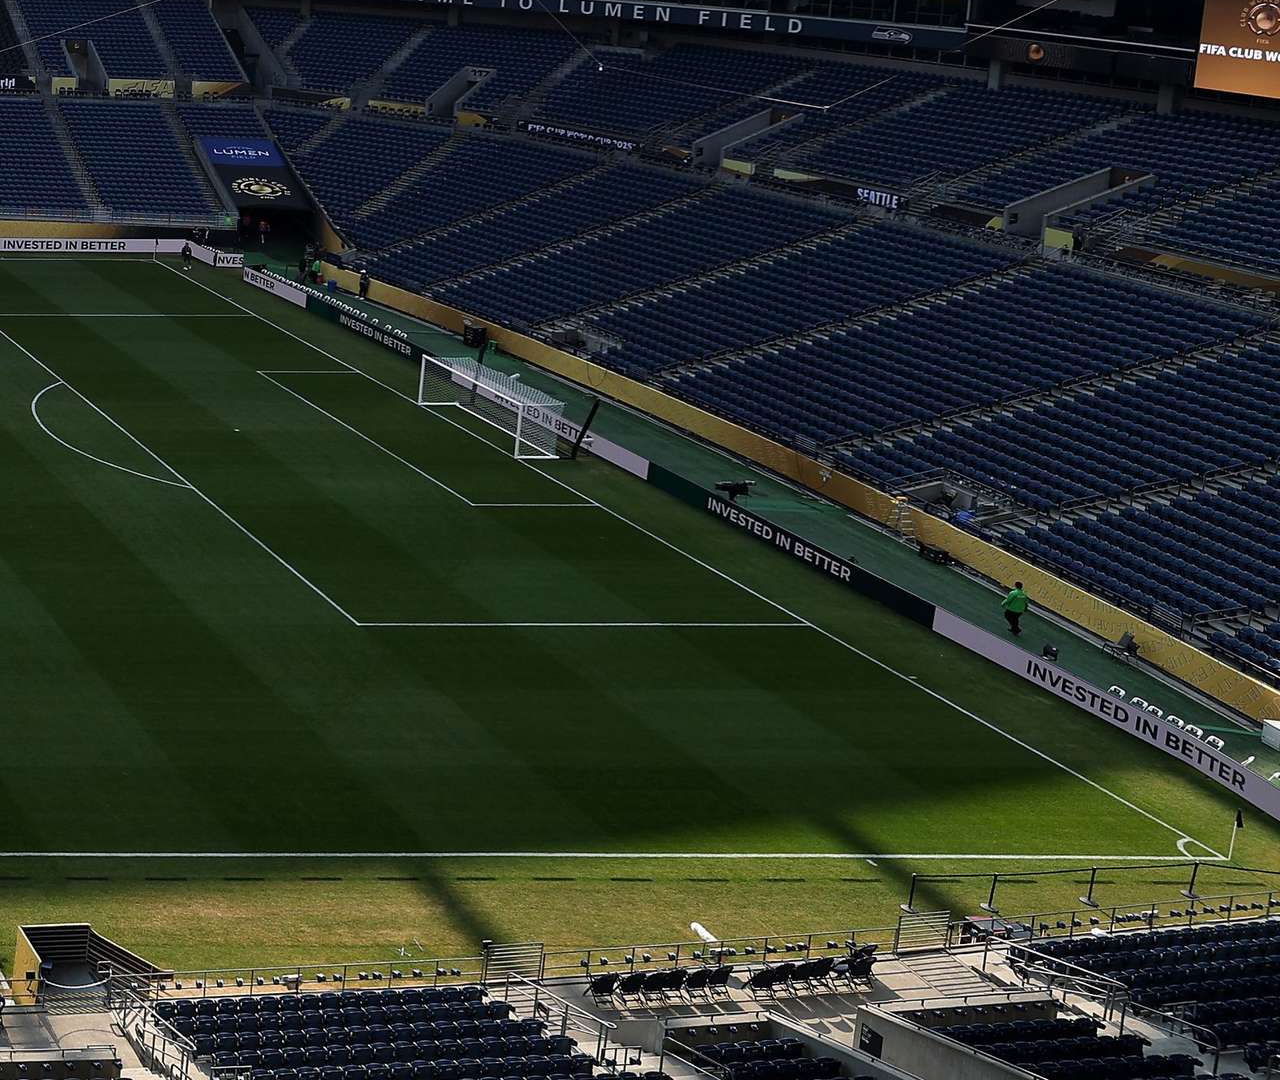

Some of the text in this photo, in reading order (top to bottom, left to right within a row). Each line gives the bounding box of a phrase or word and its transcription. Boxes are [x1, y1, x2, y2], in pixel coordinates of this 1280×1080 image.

[559, 0, 671, 22] LUMEN
[698, 10, 803, 34] FIELD
[1199, 43, 1227, 57] FIFA
[1228, 47, 1263, 60] CLUB
[213, 148, 270, 157] LUMEN
[857, 188, 900, 209] SEATTLE
[3, 239, 126, 251] INVESTED IN BETTER
[251, 274, 275, 290] BETTER
[339, 314, 411, 358] INVESTED IN BETTER
[707, 497, 851, 582] INVESTED IN BETTER
[1026, 660, 1129, 723] INVESTED
[1135, 716, 1158, 740] IN
[1165, 731, 1246, 792] BETTER
